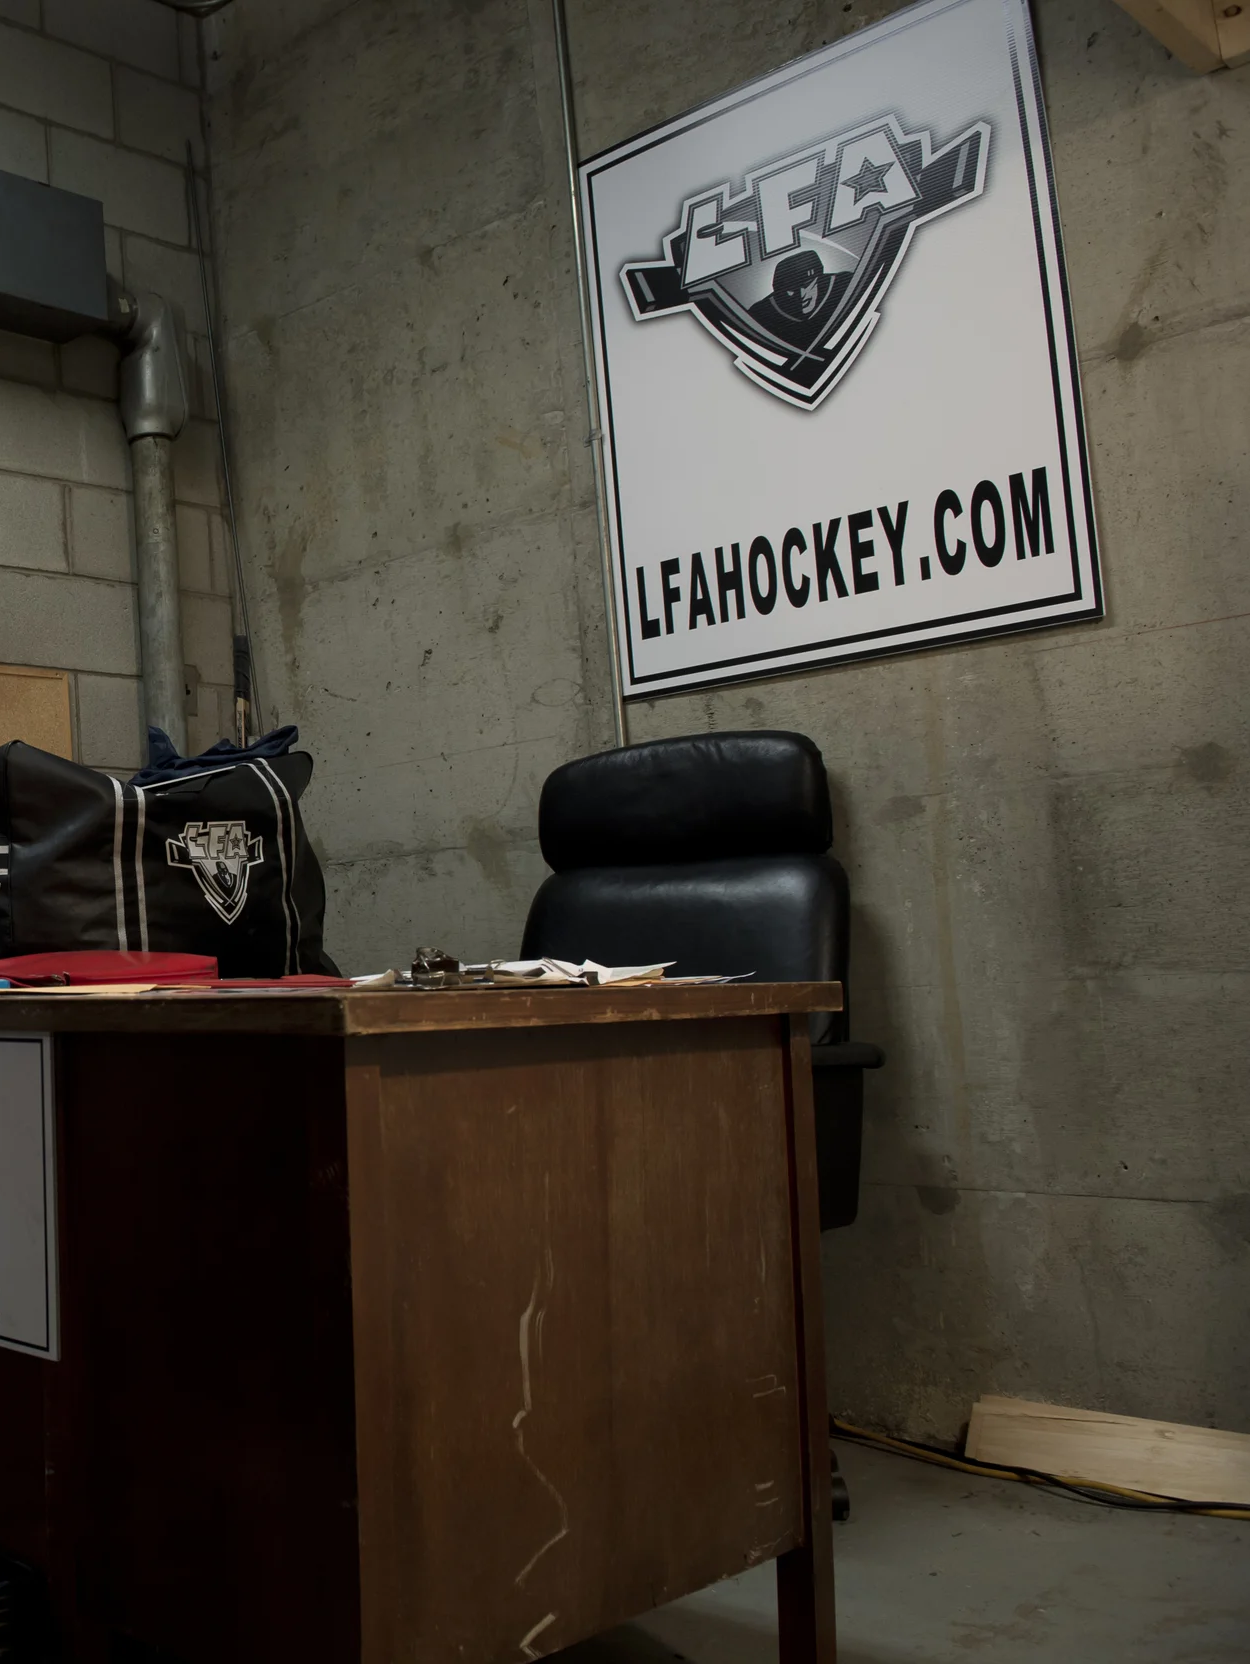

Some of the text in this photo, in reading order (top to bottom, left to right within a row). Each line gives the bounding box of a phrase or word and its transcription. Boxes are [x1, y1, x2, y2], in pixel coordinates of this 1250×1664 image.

[683, 126, 920, 287] LFA
[636, 466, 1055, 640] LFAHOCKEY.COM
[187, 825, 248, 859] LFA
